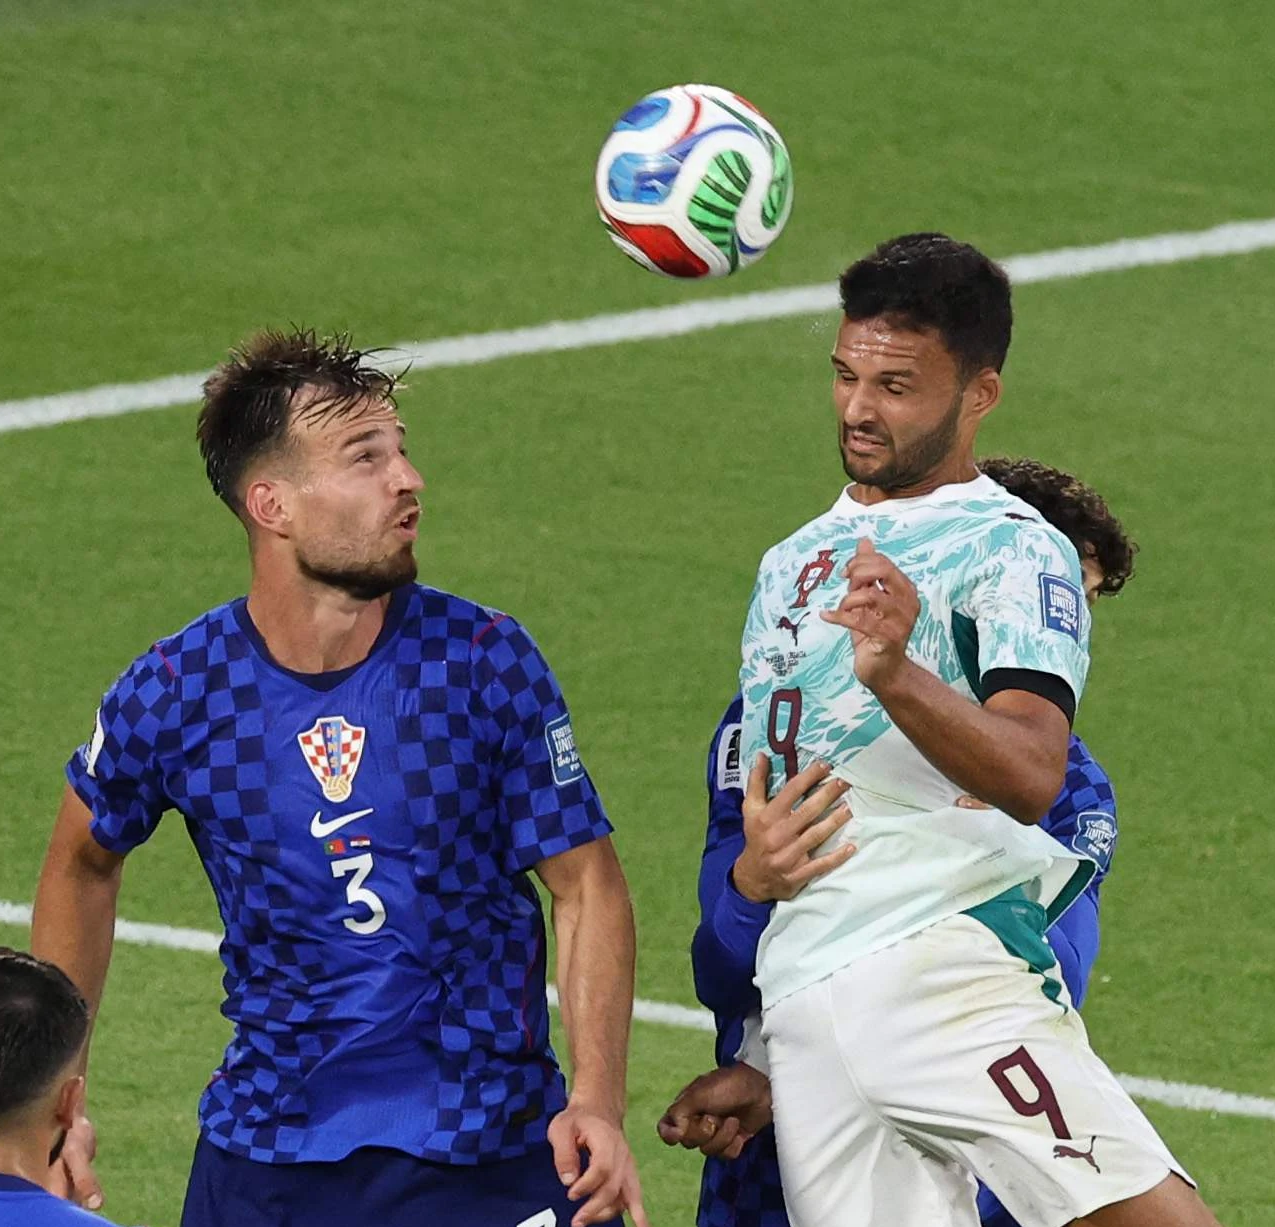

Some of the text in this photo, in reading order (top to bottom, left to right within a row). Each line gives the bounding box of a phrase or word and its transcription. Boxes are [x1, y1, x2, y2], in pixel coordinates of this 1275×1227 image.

[767, 686, 802, 783] 9
[330, 852, 386, 935] 3
[986, 1044, 1073, 1140] 9
